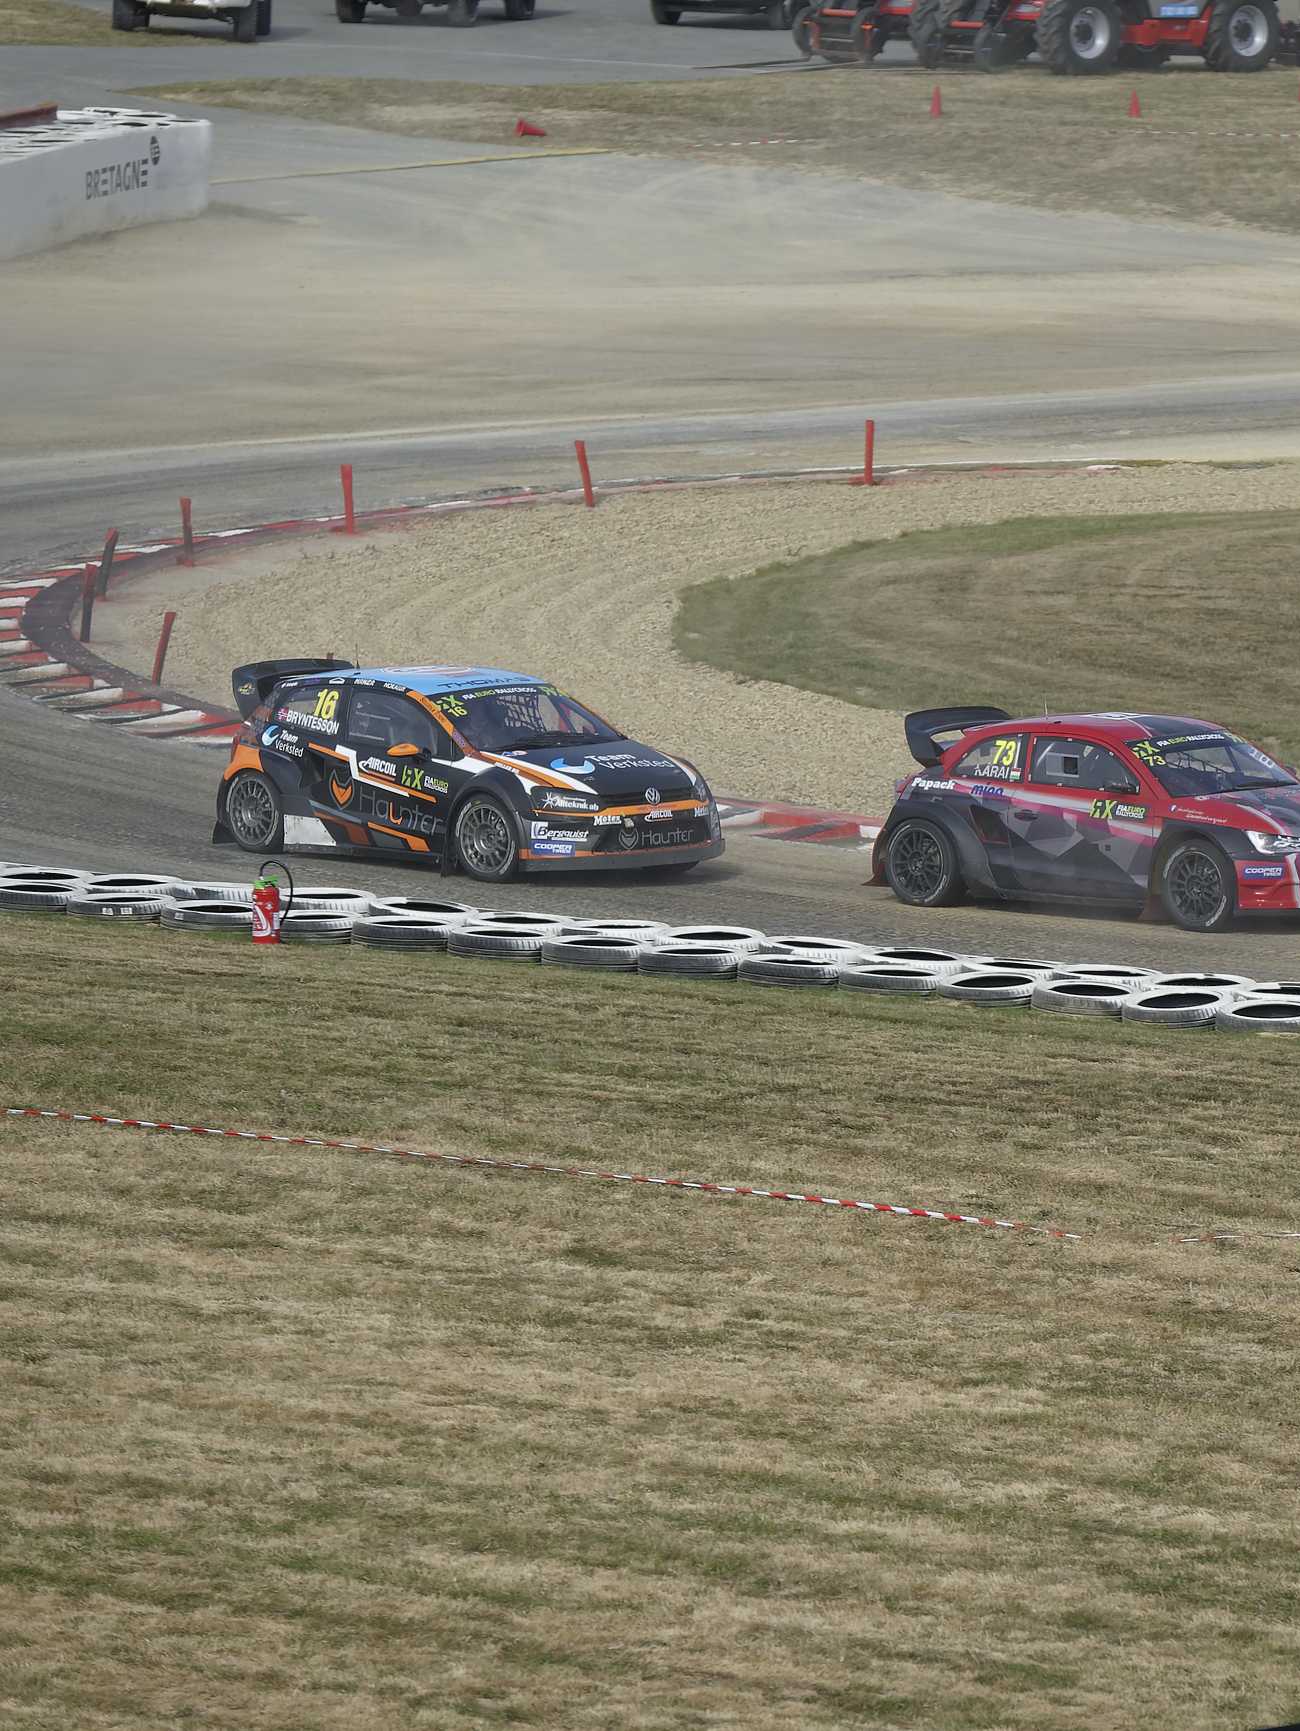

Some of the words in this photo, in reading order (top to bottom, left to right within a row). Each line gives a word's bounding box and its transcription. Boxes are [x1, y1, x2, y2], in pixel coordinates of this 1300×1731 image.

[85, 158, 149, 200] BRETAGNE
[314, 688, 339, 720] 16
[447, 706, 468, 717] 16
[286, 709, 340, 735] BRYNTESSON
[280, 730, 299, 743] Team
[275, 740, 304, 758] Verksted
[993, 739, 1017, 766] 73
[363, 757, 397, 777] AIRCOIL
[598, 759, 676, 770] Verksted
[1143, 755, 1167, 767] 73
[911, 777, 956, 791] Papack
[534, 842, 573, 851] COOPER
[1244, 867, 1283, 875] COOPER
